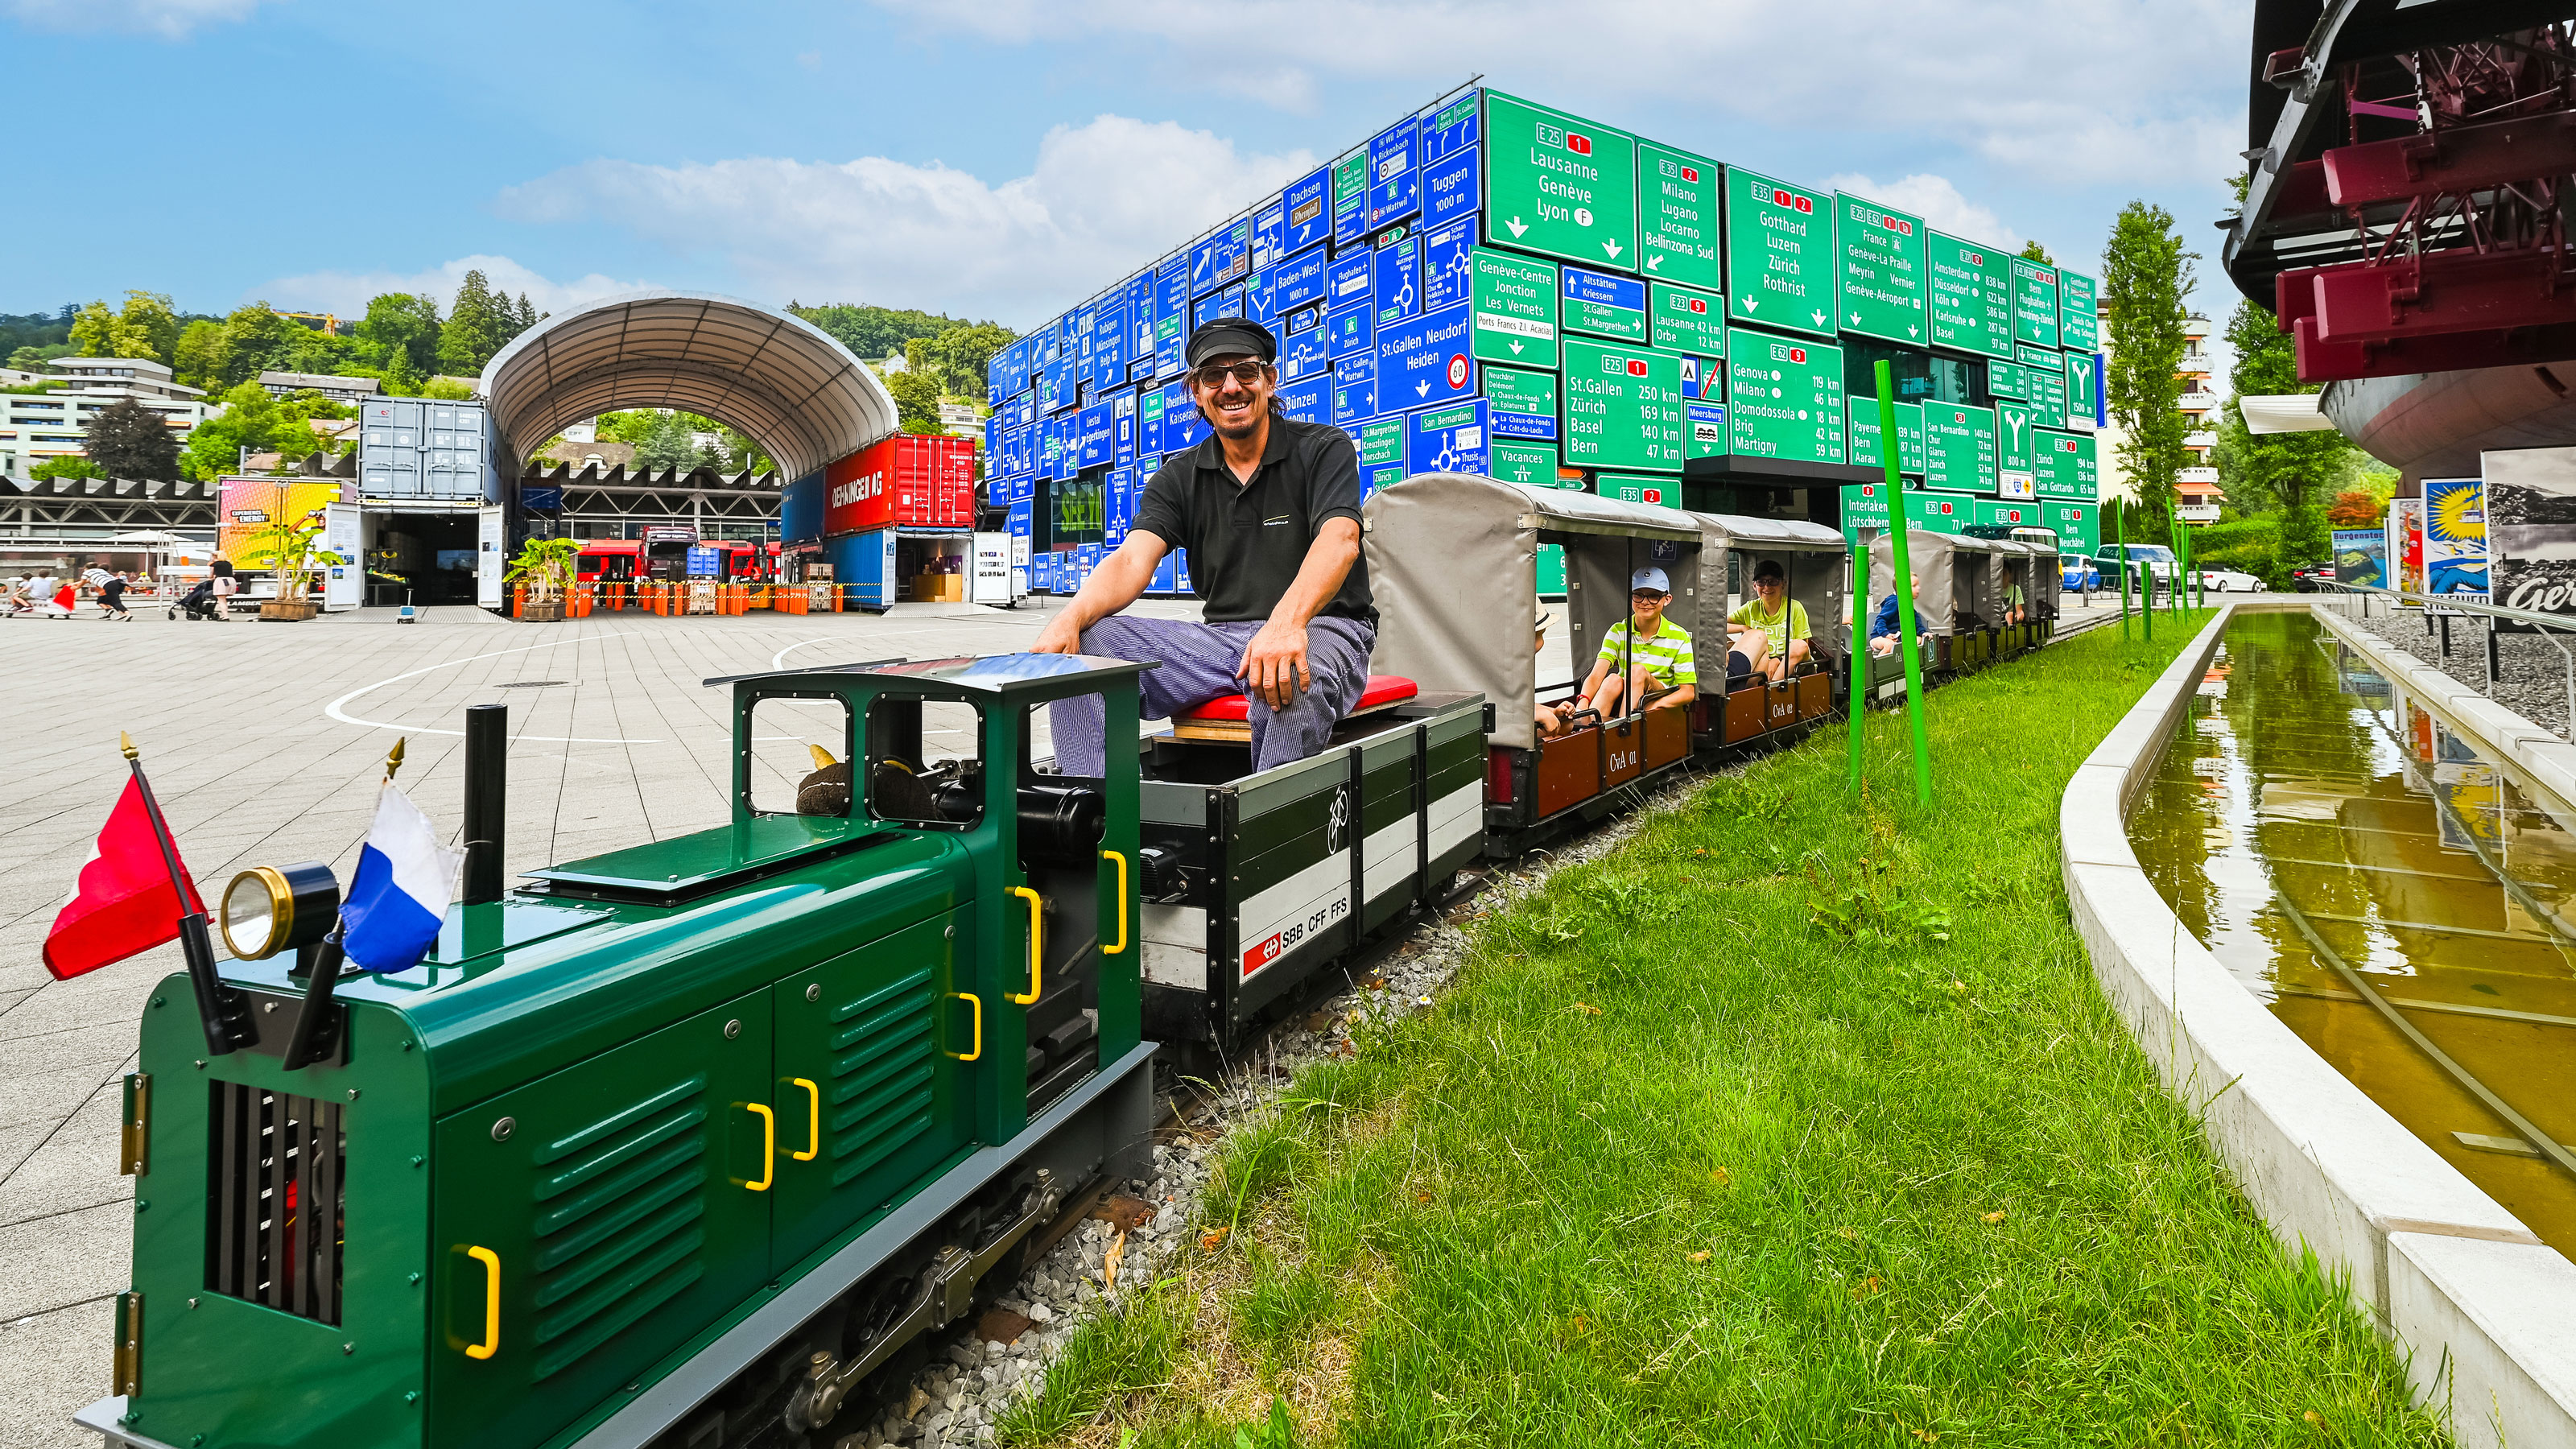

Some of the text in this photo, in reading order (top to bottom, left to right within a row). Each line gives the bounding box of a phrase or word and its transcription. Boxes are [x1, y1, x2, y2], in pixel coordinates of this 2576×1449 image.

[1396, 122, 1417, 138] Zentrum
[1378, 138, 1409, 161] Rickenbach
[1575, 137, 1581, 151] 1
[1531, 147, 1598, 182] Lausanne
[1432, 167, 1468, 193] Tuggen
[1291, 181, 1320, 206] Dachsen
[1538, 175, 1591, 204] Genève
[1662, 180, 1697, 203] Milano
[1386, 196, 1408, 214] Wattwil
[1436, 193, 1464, 213] 1000 m
[1538, 197, 1587, 224] Lyon F
[1662, 199, 1698, 221] Lugano
[1801, 199, 1806, 210] 2
[1294, 201, 1318, 224] Rheinfall
[1661, 217, 1700, 239] Locarno
[1760, 210, 1806, 237] Gotthard
[1645, 231, 1714, 260] Bellinzona Sud
[1767, 232, 1801, 254] Luzern
[1863, 229, 1887, 247] France
[1769, 254, 1800, 276] Zürich
[1848, 244, 1912, 271] Genève-La Praille
[1278, 261, 1320, 290] Baden-West
[1338, 265, 1362, 282] Flughafen
[1479, 260, 1552, 285] Genève-Centre
[1848, 262, 1915, 290] Meyrin Vernier
[1934, 261, 1970, 281] Amsterdam
[1495, 279, 1537, 299] Jonction
[1583, 275, 1617, 291] Altstätten
[1764, 274, 1806, 297] Rothrist
[1934, 277, 1969, 295] Düsseldorf
[2029, 282, 2041, 295] Bern
[1290, 287, 1309, 302] 1000 m
[1583, 287, 1614, 303] Kriessern
[1845, 281, 1909, 307] Genève-Aéroport
[1934, 292, 1950, 306] Köln
[1486, 295, 1544, 317] Les Vernets
[1695, 301, 1700, 312] 9
[1656, 313, 1721, 336] Lausanne 42 km
[1935, 308, 1966, 326] Karlsruhe
[1099, 319, 1117, 336] Rubigen
[1426, 317, 1468, 345] Neudorf
[1478, 316, 1552, 336] Ports Francs Acacias
[1936, 324, 1955, 340] Basel
[1096, 334, 1121, 353] Münsingen
[1344, 336, 1359, 349] Zürich
[1656, 329, 1721, 350] Orbe 12 km
[1100, 353, 1111, 368] Belp
[1353, 357, 1368, 369] Gallen
[1407, 350, 1439, 371] Heiden
[1635, 362, 1640, 374] 1
[1344, 369, 1364, 382] Wattwil
[1453, 365, 1463, 378] 60
[1488, 371, 1516, 382] Neuchâtel
[1734, 363, 1839, 391] Genova 119 km
[1488, 381, 1515, 390] Delémont
[1734, 381, 1840, 407] Milano 46 km
[1286, 393, 1317, 411] Bünzen
[1497, 391, 1540, 402] Chaux-de-Fonds
[1638, 386, 1678, 403] 250 km
[1337, 407, 1354, 419] Uznach
[1501, 401, 1525, 411] Eplatures
[1571, 397, 1678, 423] Zürich 169 km
[1690, 407, 1722, 422] Meersburg
[1734, 400, 1840, 425] Domodossola 18 km
[1086, 412, 1100, 427] Liestal
[1424, 411, 1472, 428] San Bernardino
[1509, 415, 1551, 427] Chaux-de-Fonds
[1086, 427, 1110, 445] Egerkingen
[1509, 424, 1543, 435] Crêt-du-Locle
[1571, 418, 1678, 442] Basel 140 km
[1735, 418, 1841, 442] Brig 42 km
[1854, 420, 1921, 440] Payerne 139 km
[1927, 422, 1970, 436] San Bernardino
[1363, 437, 1395, 451] Kreuzlingen
[1735, 436, 1841, 457] Martigny 59 km
[1855, 436, 1922, 454] Bern 87 km
[1928, 435, 1941, 444] Chur
[1086, 448, 1098, 460] Olten
[1363, 451, 1391, 462] Rorschach
[1461, 451, 1478, 463] Thusis
[1501, 450, 1543, 464] Vacances
[1571, 438, 1679, 460] Bern 47 km
[1928, 447, 1946, 457] Glarus
[1856, 452, 1922, 468] Aarau 11 km
[1929, 459, 1946, 469] Zürich
[2008, 456, 2025, 467] 800 m
[2037, 453, 2054, 465] Zürich
[1374, 472, 1391, 481] Zürich
[1929, 471, 1947, 481] Luzern
[2037, 467, 2055, 478] Luzern
[871, 470, 882, 497] AG
[1566, 481, 1575, 489] Sion
[2037, 480, 2074, 493] San Gottardo
[1848, 498, 1888, 513] Interlaken
[1906, 518, 1922, 530] Bern
[2066, 523, 2079, 535] Bern
[2059, 537, 2085, 547] Neuchâtel
[1773, 703, 1793, 718] CvA 02
[1610, 749, 1637, 772] CvA 01
[1282, 897, 1347, 948] SBB CFF FFS
